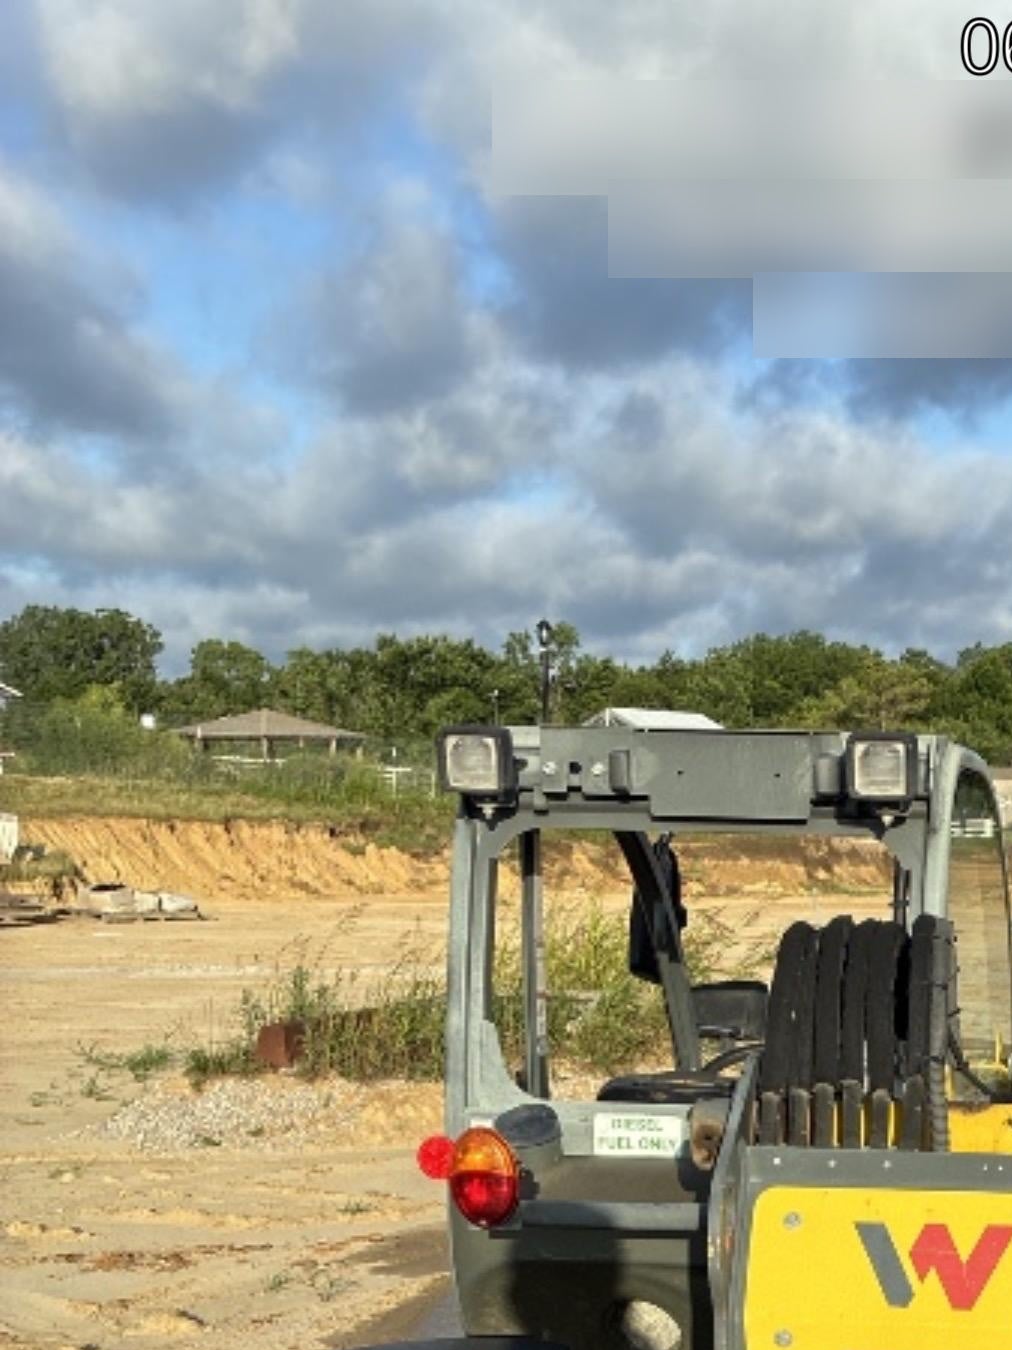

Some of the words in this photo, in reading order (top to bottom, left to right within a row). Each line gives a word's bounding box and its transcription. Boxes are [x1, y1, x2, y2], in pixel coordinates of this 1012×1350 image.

[611, 1117, 664, 1132] DIESEL
[597, 1136, 633, 1150] FUEL
[638, 1136, 677, 1151] ONLY
